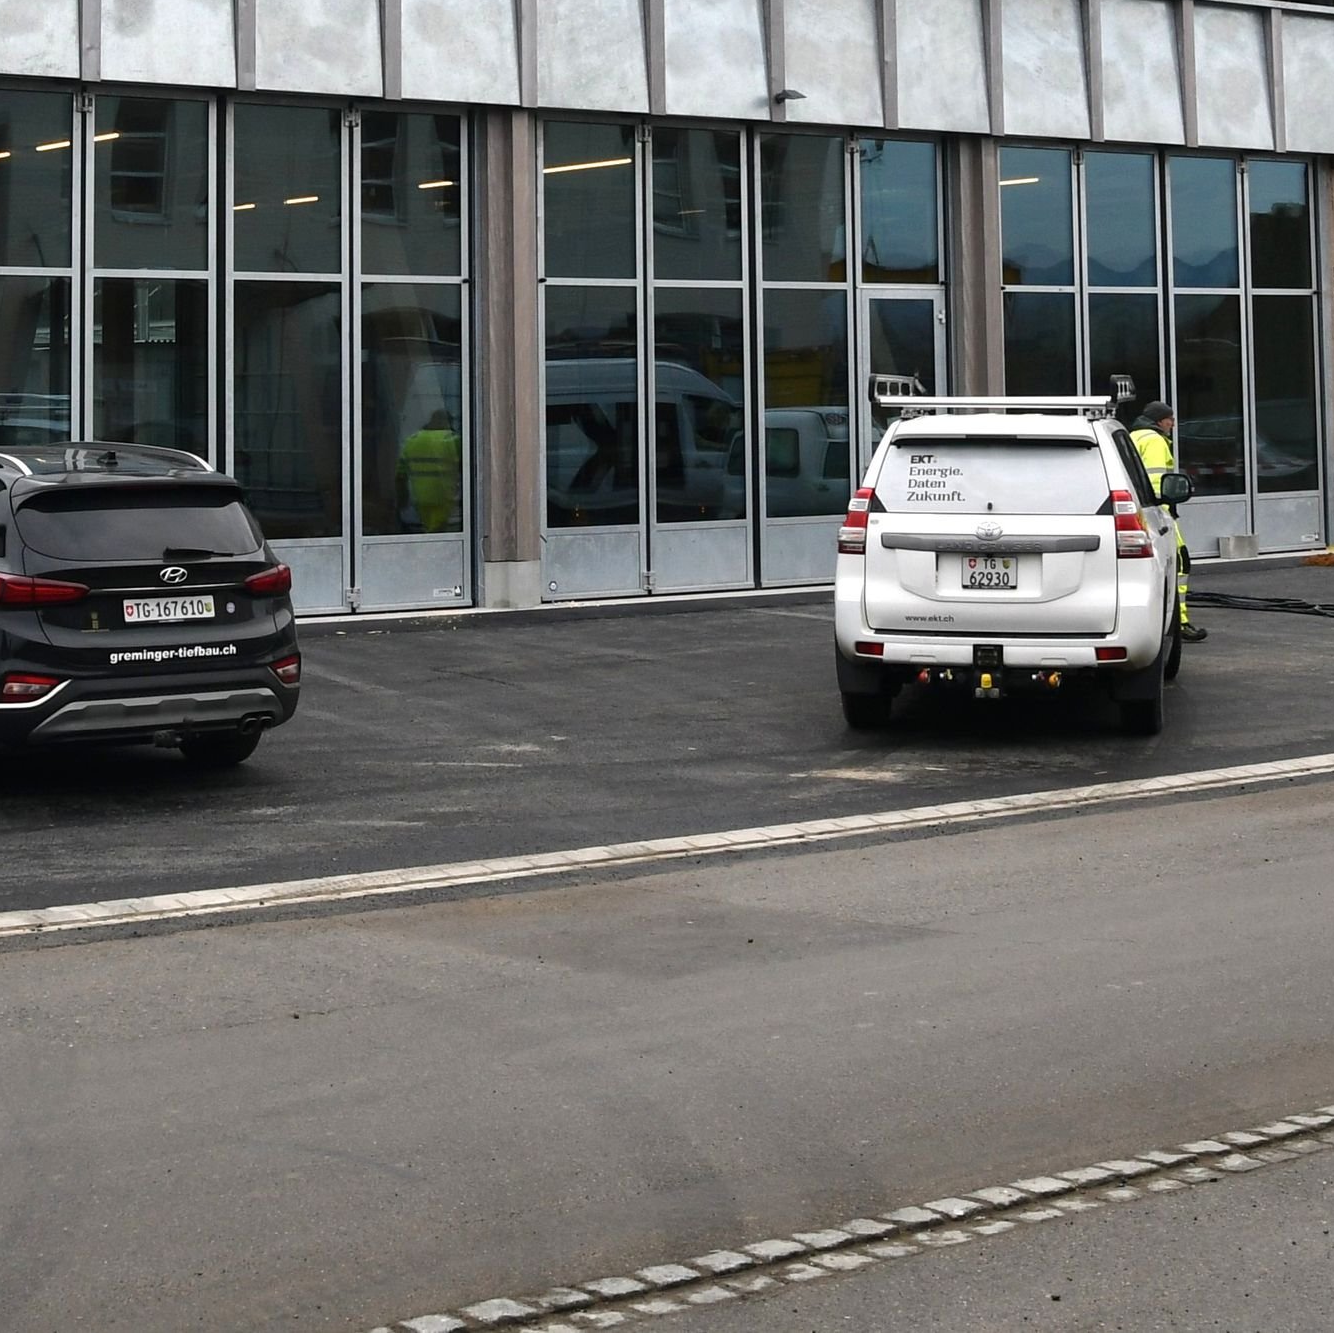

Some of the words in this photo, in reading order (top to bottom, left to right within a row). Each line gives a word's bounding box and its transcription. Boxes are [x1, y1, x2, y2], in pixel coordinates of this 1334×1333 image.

[909, 466, 964, 478] Energie.
[906, 491, 966, 502] Zukunft.
[983, 559, 997, 569] TG
[969, 571, 1010, 586] 62930
[905, 614, 955, 622] www.ekt.ch
[109, 644, 237, 665] greminger-tiefbau.ch
